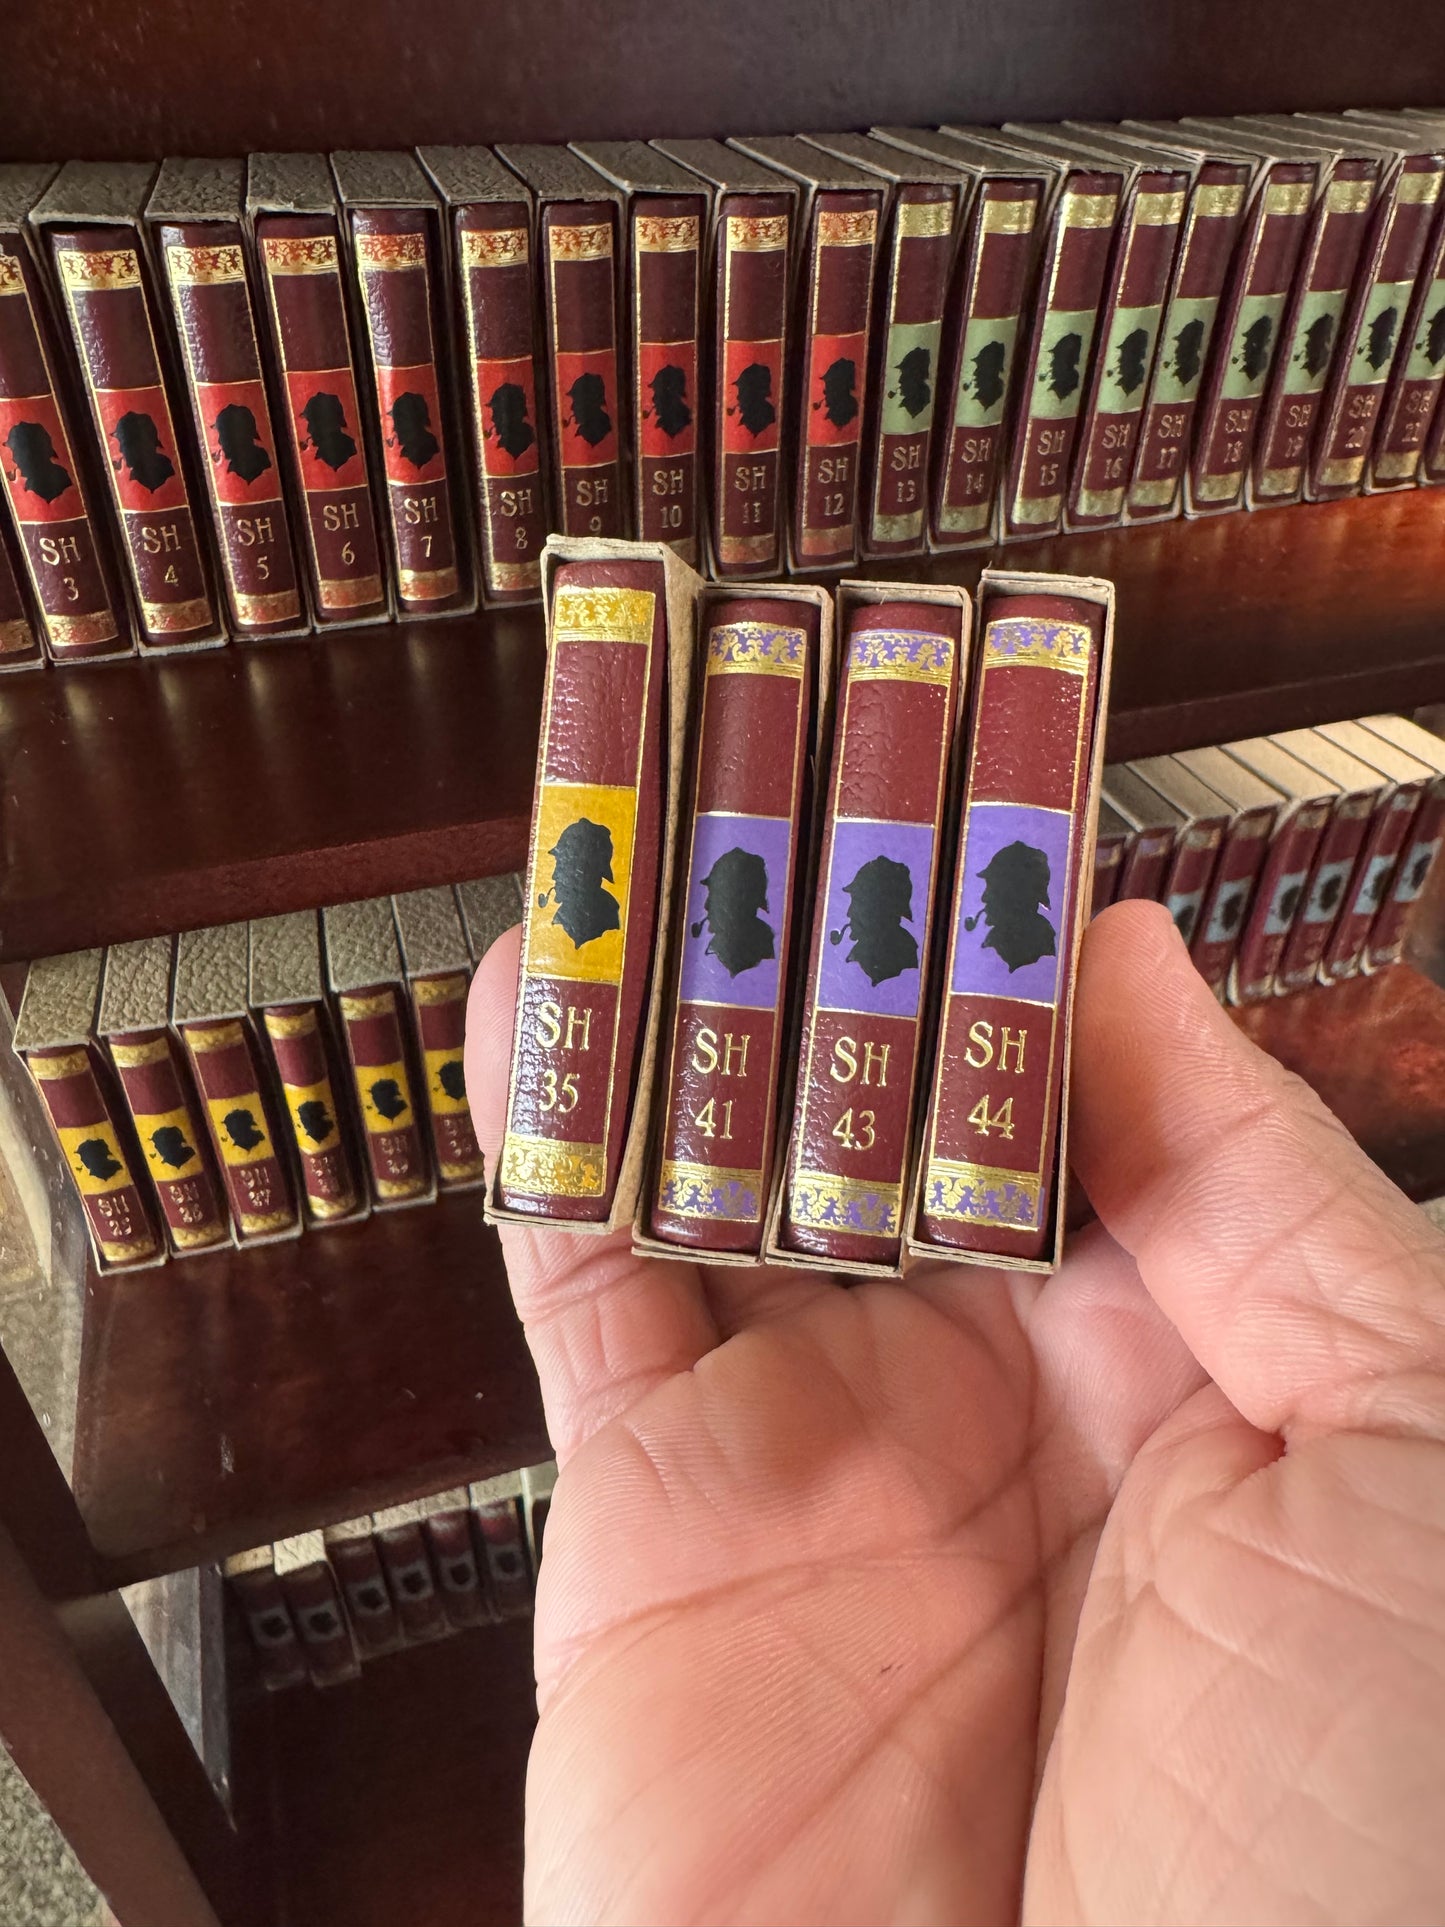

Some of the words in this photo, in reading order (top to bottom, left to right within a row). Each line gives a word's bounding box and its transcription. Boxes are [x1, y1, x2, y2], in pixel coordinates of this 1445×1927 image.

[1286, 403, 1313, 428] SH
[1350, 394, 1376, 419] SH
[1158, 413, 1186, 439] SH
[1225, 408, 1251, 433] SH
[1037, 429, 1066, 456] SH
[1101, 423, 1131, 449] SH
[890, 444, 921, 472] SH
[961, 437, 991, 463] SH
[1156, 446, 1178, 470] 17
[734, 465, 767, 492] SH
[817, 457, 849, 484] SH
[1039, 463, 1059, 487] 15
[1104, 456, 1124, 480] 16
[576, 478, 609, 507] SH
[652, 468, 684, 496] SH
[896, 480, 916, 503] 13
[965, 472, 985, 495] 14
[403, 496, 439, 525] SH
[500, 488, 533, 517] SH
[742, 502, 762, 524] 11
[823, 492, 845, 516] 12
[322, 502, 360, 532] SH
[589, 515, 601, 537] 9
[660, 505, 683, 529] 10
[141, 524, 182, 554] SH
[236, 516, 275, 546] SH
[515, 526, 528, 550] 8
[39, 536, 81, 566] SH
[341, 540, 356, 566] 6
[420, 535, 433, 558] 7
[164, 564, 179, 587] 4
[256, 555, 270, 580] 5
[63, 577, 79, 601] 3
[534, 1001, 592, 1051] SH
[691, 1028, 751, 1077] SH
[963, 1020, 1028, 1074] SH
[829, 1036, 891, 1087] SH
[538, 1068, 580, 1113] 35
[694, 1097, 733, 1140] 41
[832, 1107, 876, 1151] 43
[967, 1094, 1015, 1140] 44
